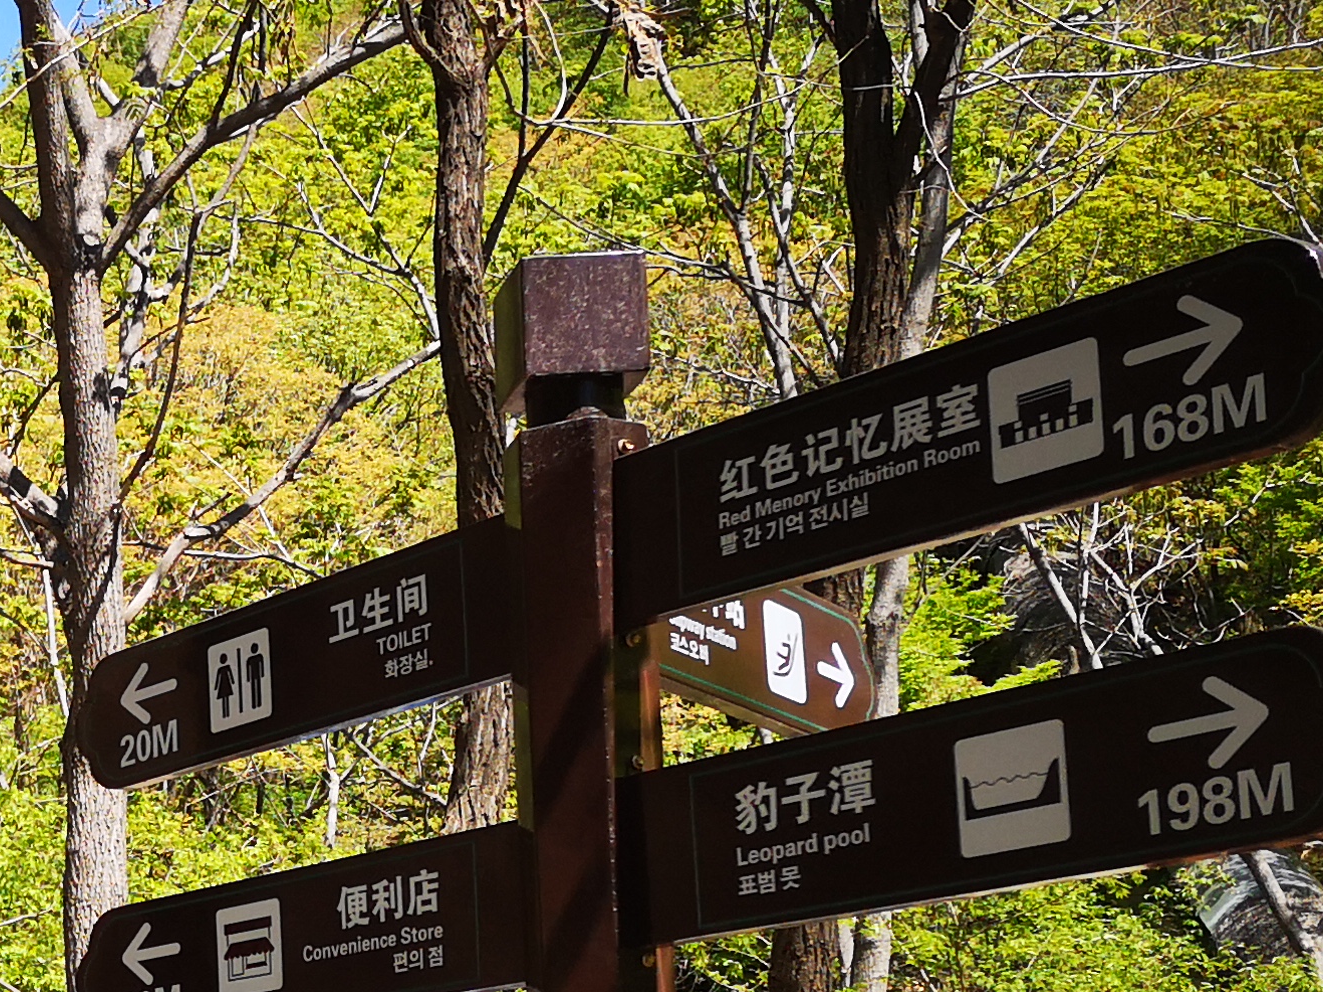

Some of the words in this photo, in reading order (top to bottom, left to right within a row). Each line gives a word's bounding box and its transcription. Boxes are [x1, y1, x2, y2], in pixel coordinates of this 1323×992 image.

[719, 384, 981, 503] 红色记忆展室
[1112, 372, 1267, 460] 168M
[718, 505, 752, 530] Red
[755, 487, 822, 519] Menory
[826, 458, 919, 498] Exhibition
[923, 440, 981, 469] Room
[765, 511, 805, 541] 기억
[809, 491, 871, 530] 전시실
[328, 573, 428, 644] 卫生间
[376, 622, 432, 655] TOILET
[120, 718, 179, 769] 20M
[734, 759, 876, 835] 豹子潭
[1137, 761, 1295, 836] 198M
[736, 832, 819, 867] Leopard
[823, 822, 871, 855] pool
[336, 868, 440, 930] 便利店
[738, 869, 777, 896] 표범
[780, 865, 801, 891] 못
[303, 934, 397, 963] Convenience
[400, 925, 444, 945] Store
